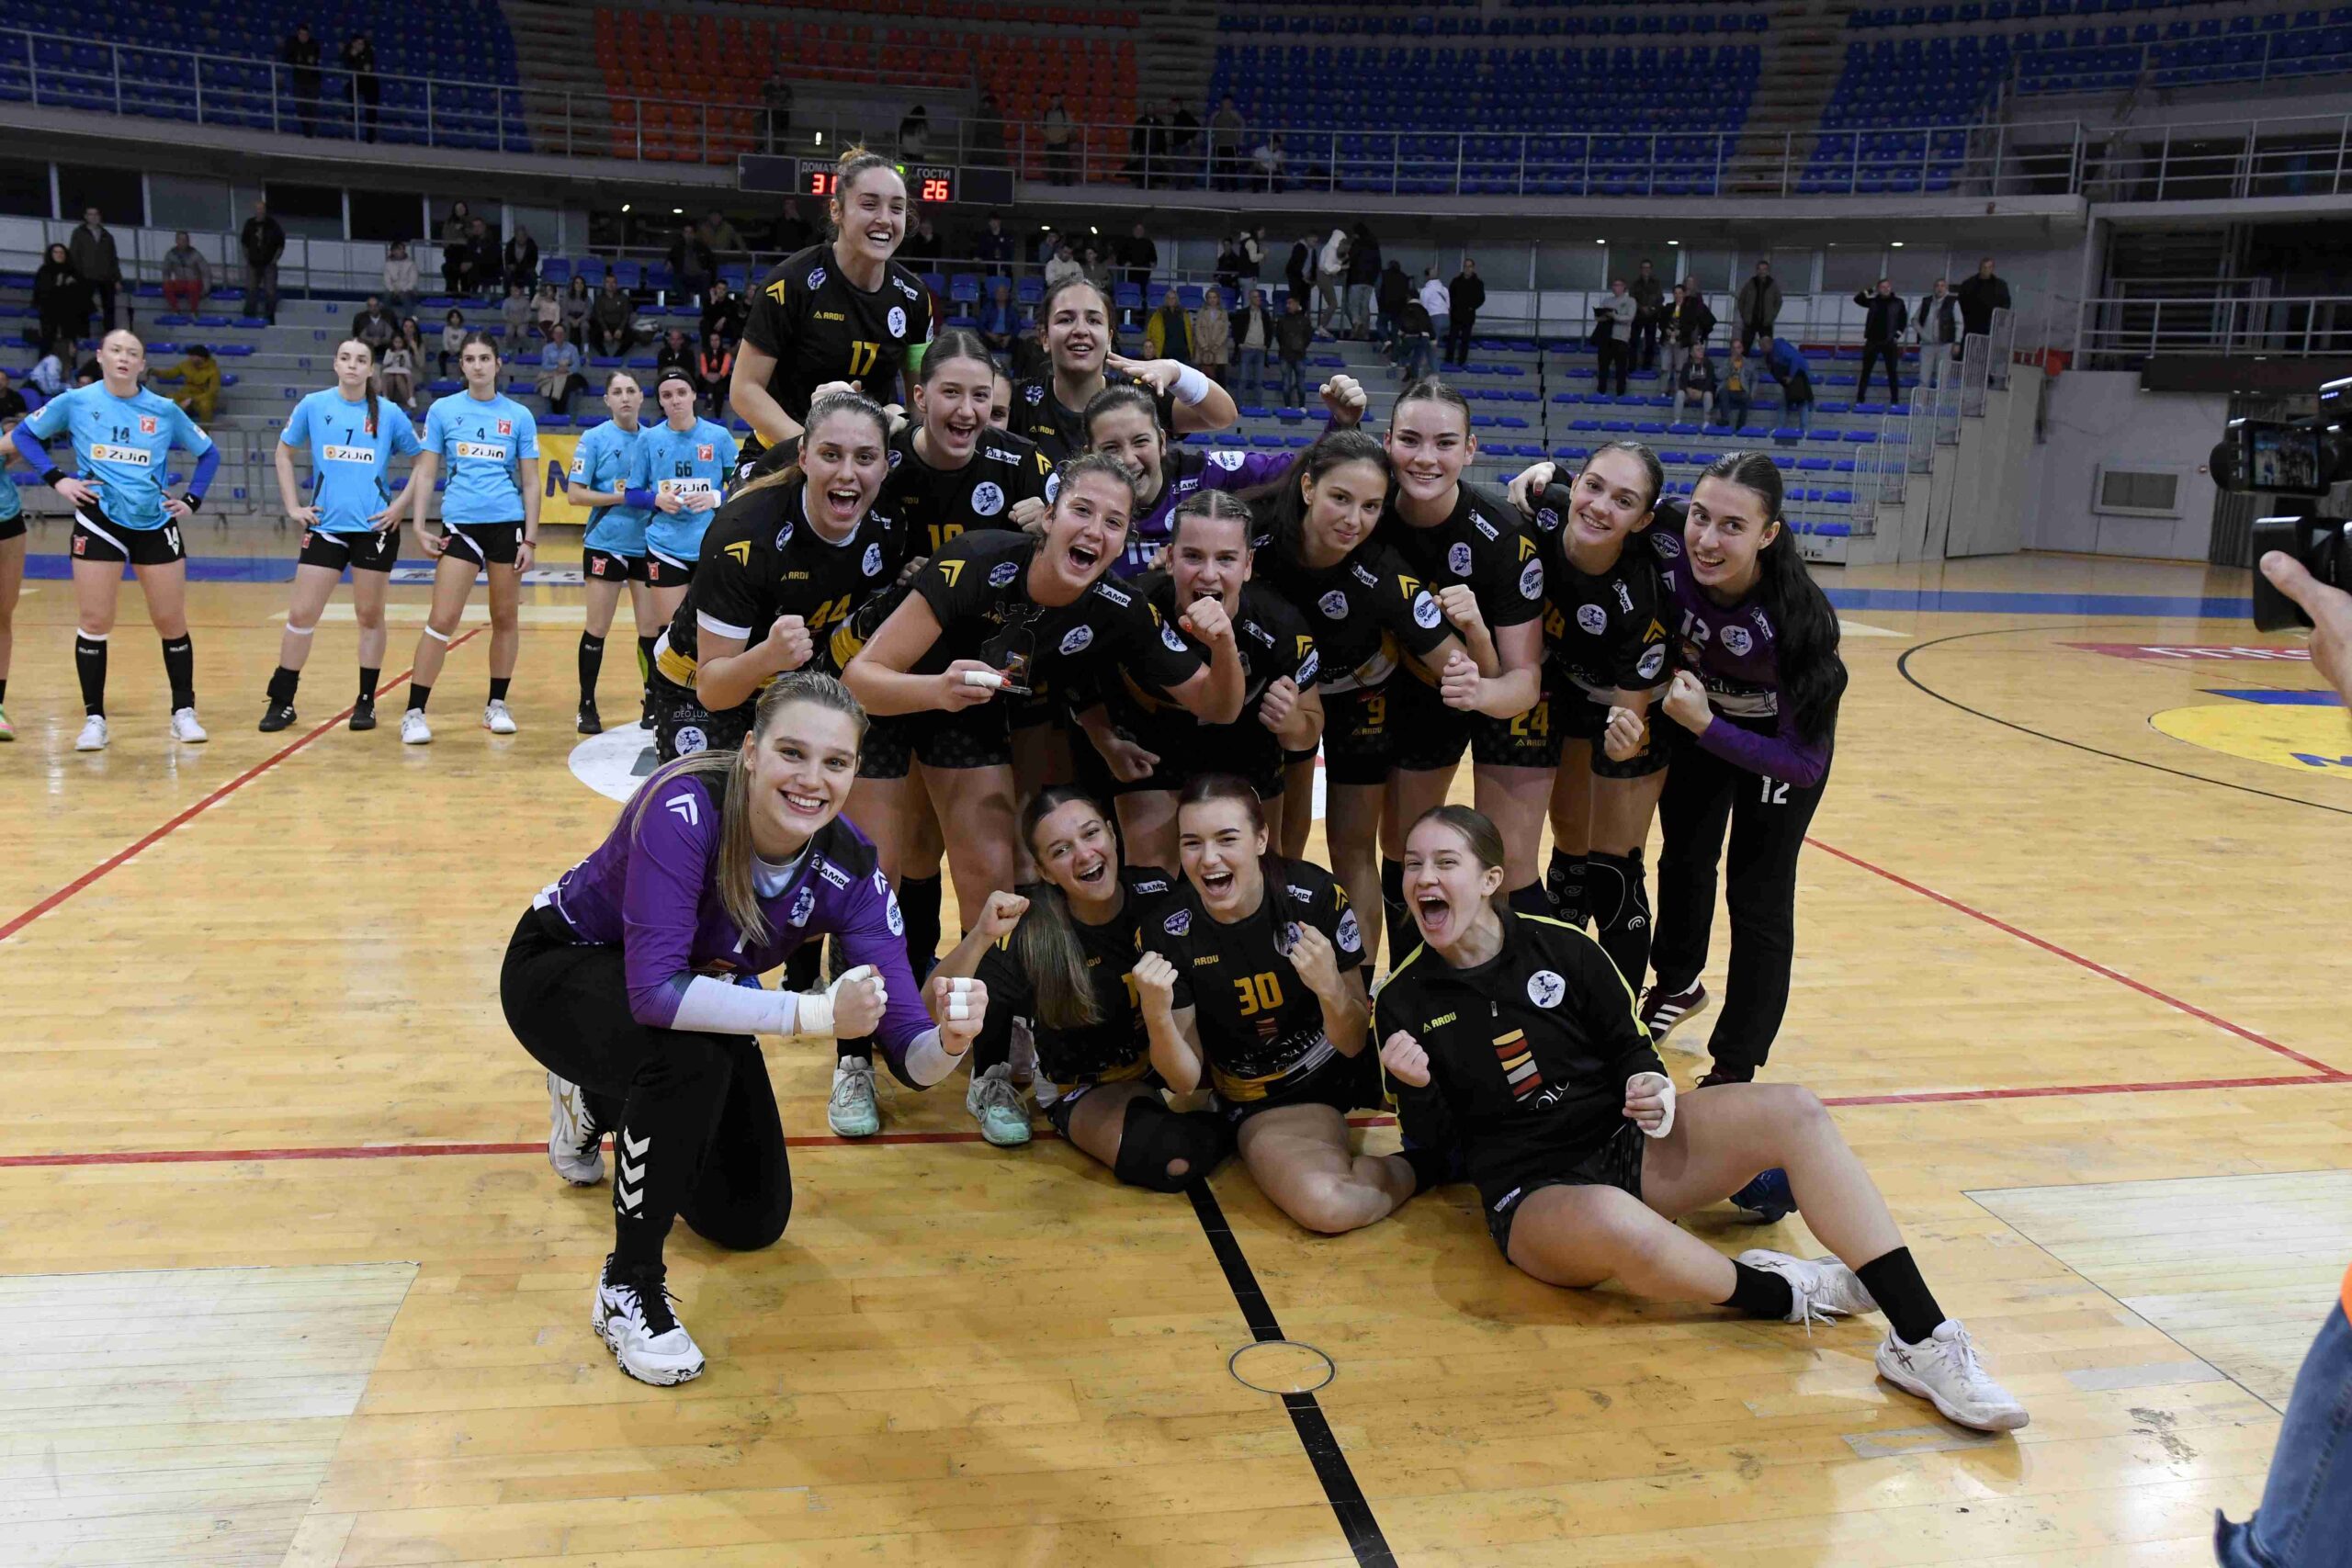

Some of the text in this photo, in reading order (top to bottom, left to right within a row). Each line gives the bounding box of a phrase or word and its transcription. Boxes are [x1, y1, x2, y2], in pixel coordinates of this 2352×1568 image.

[917, 168, 950, 179] ГОСТИ
[811, 174, 838, 195] 31
[922, 180, 948, 200] 26
[848, 340, 880, 376] 17
[111, 426, 130, 444] 14
[345, 428, 354, 446] 7
[476, 427, 485, 441] 4
[674, 460, 693, 478] 66
[806, 593, 852, 629] 44
[1679, 607, 1712, 650] 12
[693, 710, 709, 718] LUX
[1760, 774, 1791, 805] 12
[1193, 954, 1220, 965] ARDU
[1233, 971, 1285, 1017] 30
[1430, 1011, 1457, 1028] ARDU
